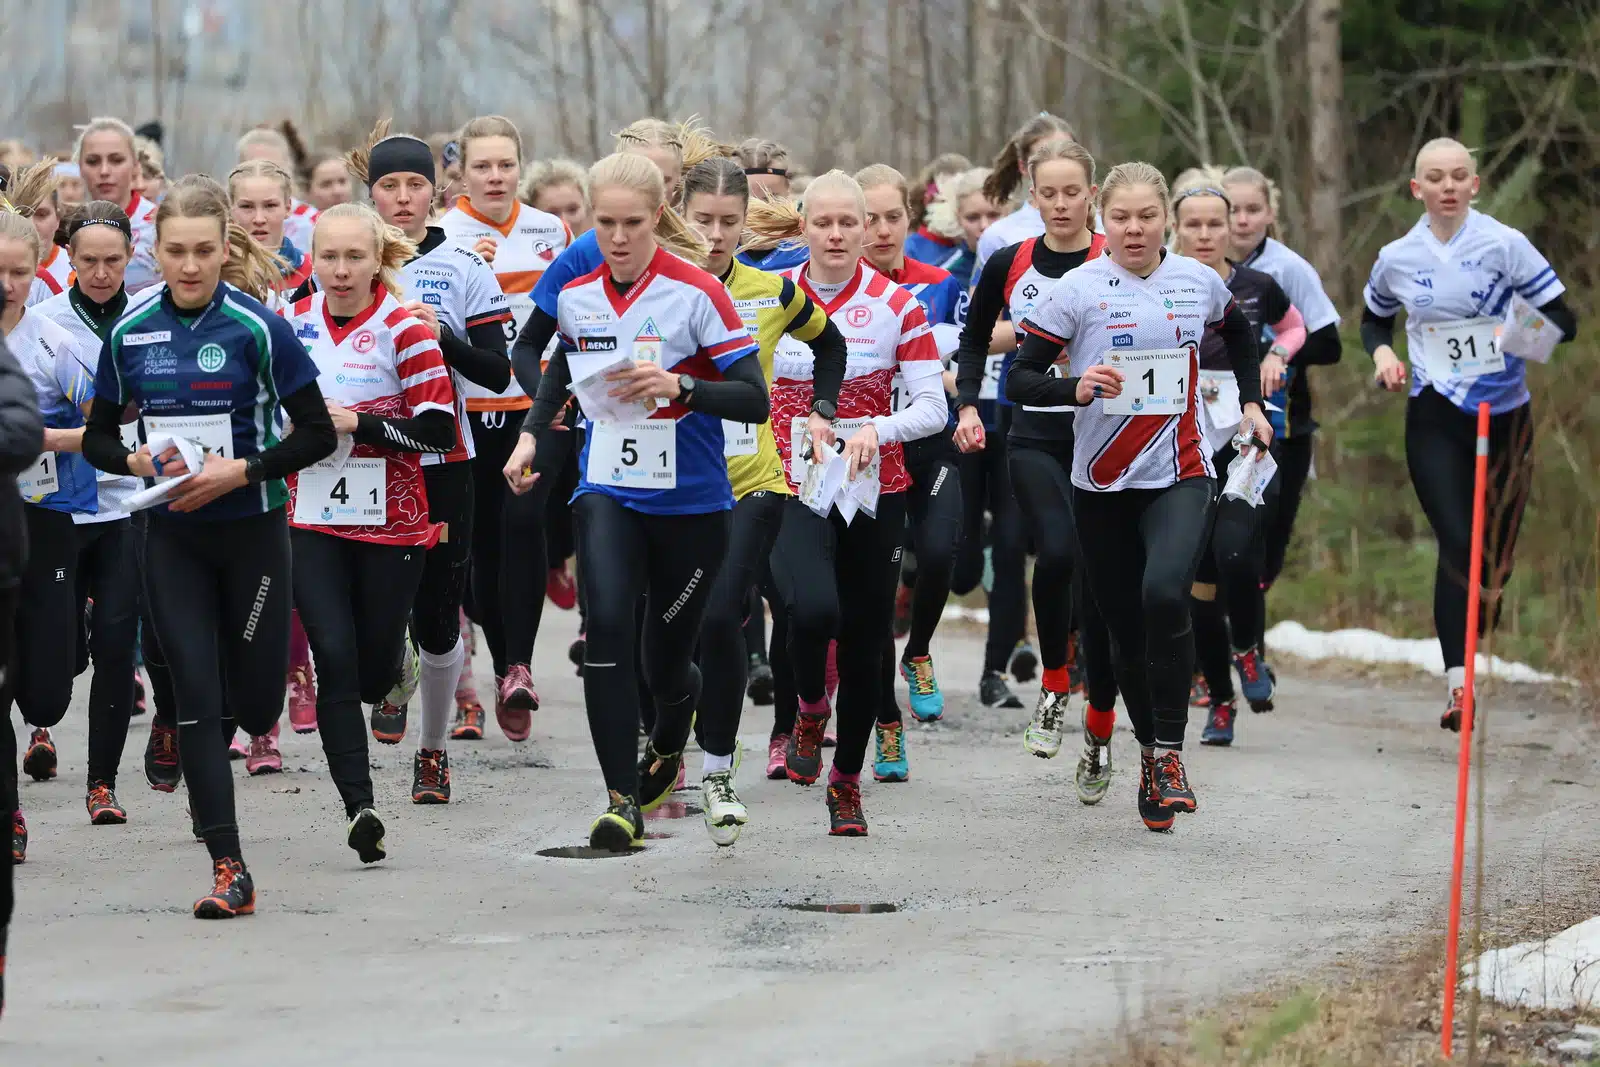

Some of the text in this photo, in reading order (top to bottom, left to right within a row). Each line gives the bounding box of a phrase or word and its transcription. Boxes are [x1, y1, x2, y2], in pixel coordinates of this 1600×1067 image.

[454, 247, 483, 267] TRIMTEX
[414, 269, 453, 277] JENSUU
[733, 299, 777, 308] LUMNITE
[75, 303, 99, 330] noname
[1109, 311, 1132, 319] ABLOY
[1106, 322, 1138, 330] motonet
[125, 333, 168, 343] LUMNITE
[845, 337, 877, 345] oname
[38, 337, 56, 359] TRIMTEX
[1447, 335, 1477, 361] 31
[1488, 341, 1496, 354] 1
[144, 359, 178, 367] HELSINKI
[1142, 368, 1155, 395] 1
[1177, 377, 1184, 394] 1
[191, 399, 233, 407] noname
[621, 438, 639, 467] 5
[658, 450, 668, 468] 1
[40, 457, 49, 475] 1
[930, 465, 949, 497] noname
[330, 476, 350, 505] 4
[369, 487, 378, 505] 1
[662, 567, 704, 624] noname
[243, 575, 271, 642] noname
